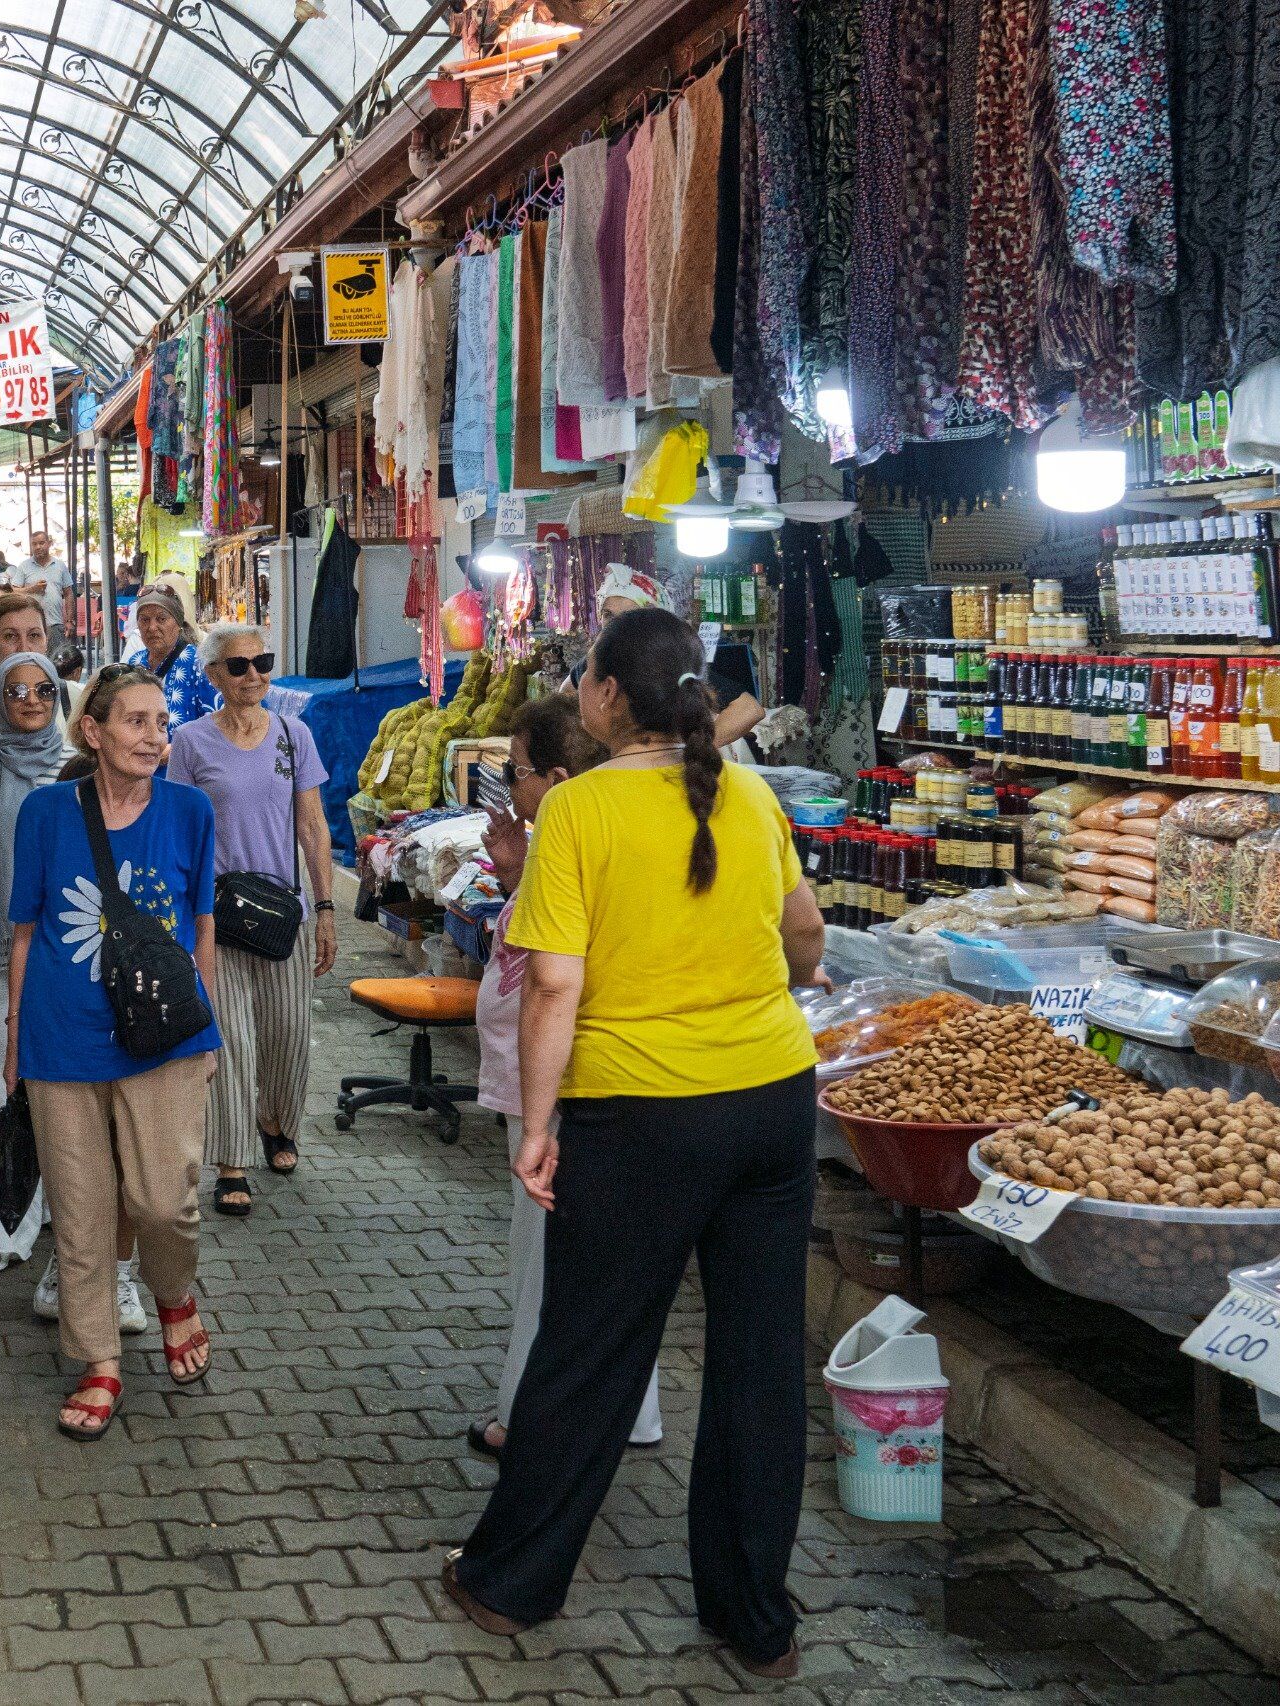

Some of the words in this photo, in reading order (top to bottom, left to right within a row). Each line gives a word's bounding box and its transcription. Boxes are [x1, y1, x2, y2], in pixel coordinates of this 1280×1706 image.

[4, 378, 24, 408] 97
[29, 376, 49, 406] 85
[501, 521, 516, 533] 100
[997, 1179, 1050, 1208] 150
[1204, 1325, 1269, 1362] 400
